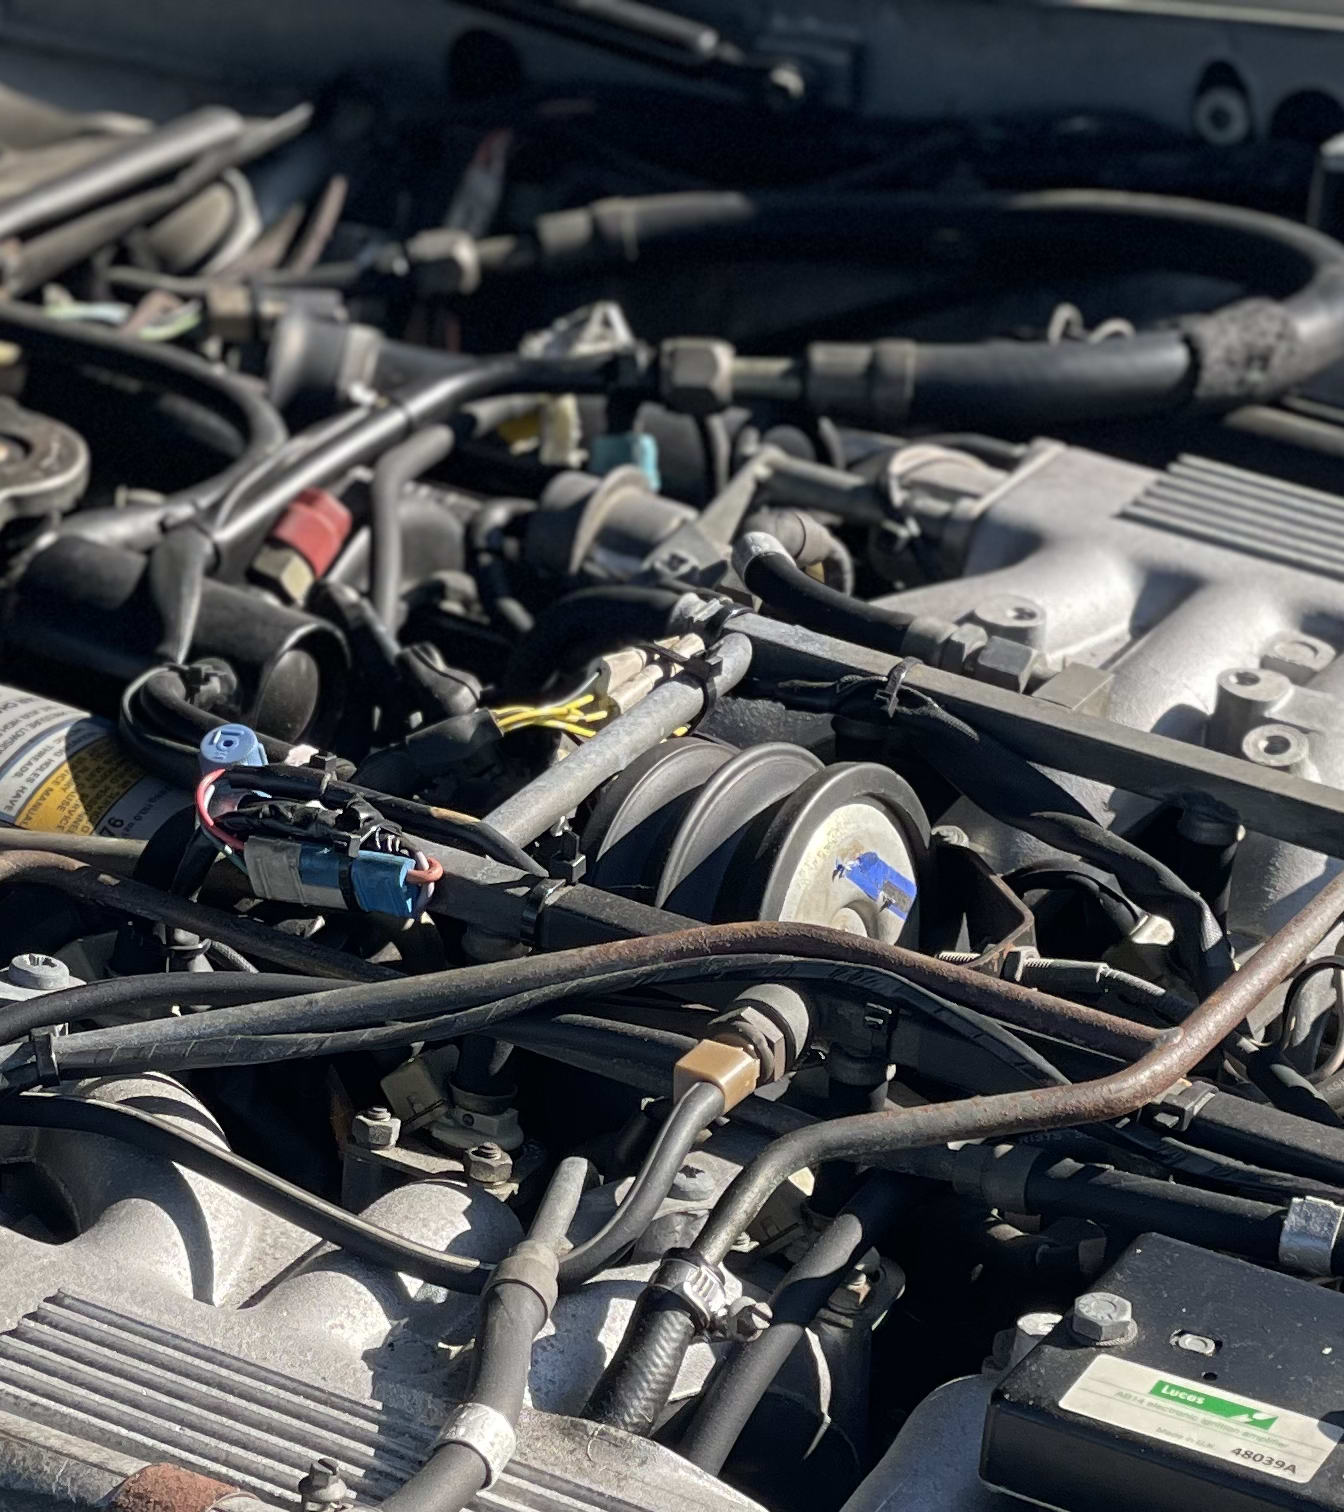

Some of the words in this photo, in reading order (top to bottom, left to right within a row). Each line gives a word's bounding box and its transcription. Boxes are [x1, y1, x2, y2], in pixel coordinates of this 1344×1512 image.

[1, 785, 29, 812] HAVE
[1161, 1385, 1205, 1404] Lucas
[1231, 1448, 1297, 1474] 48039A
